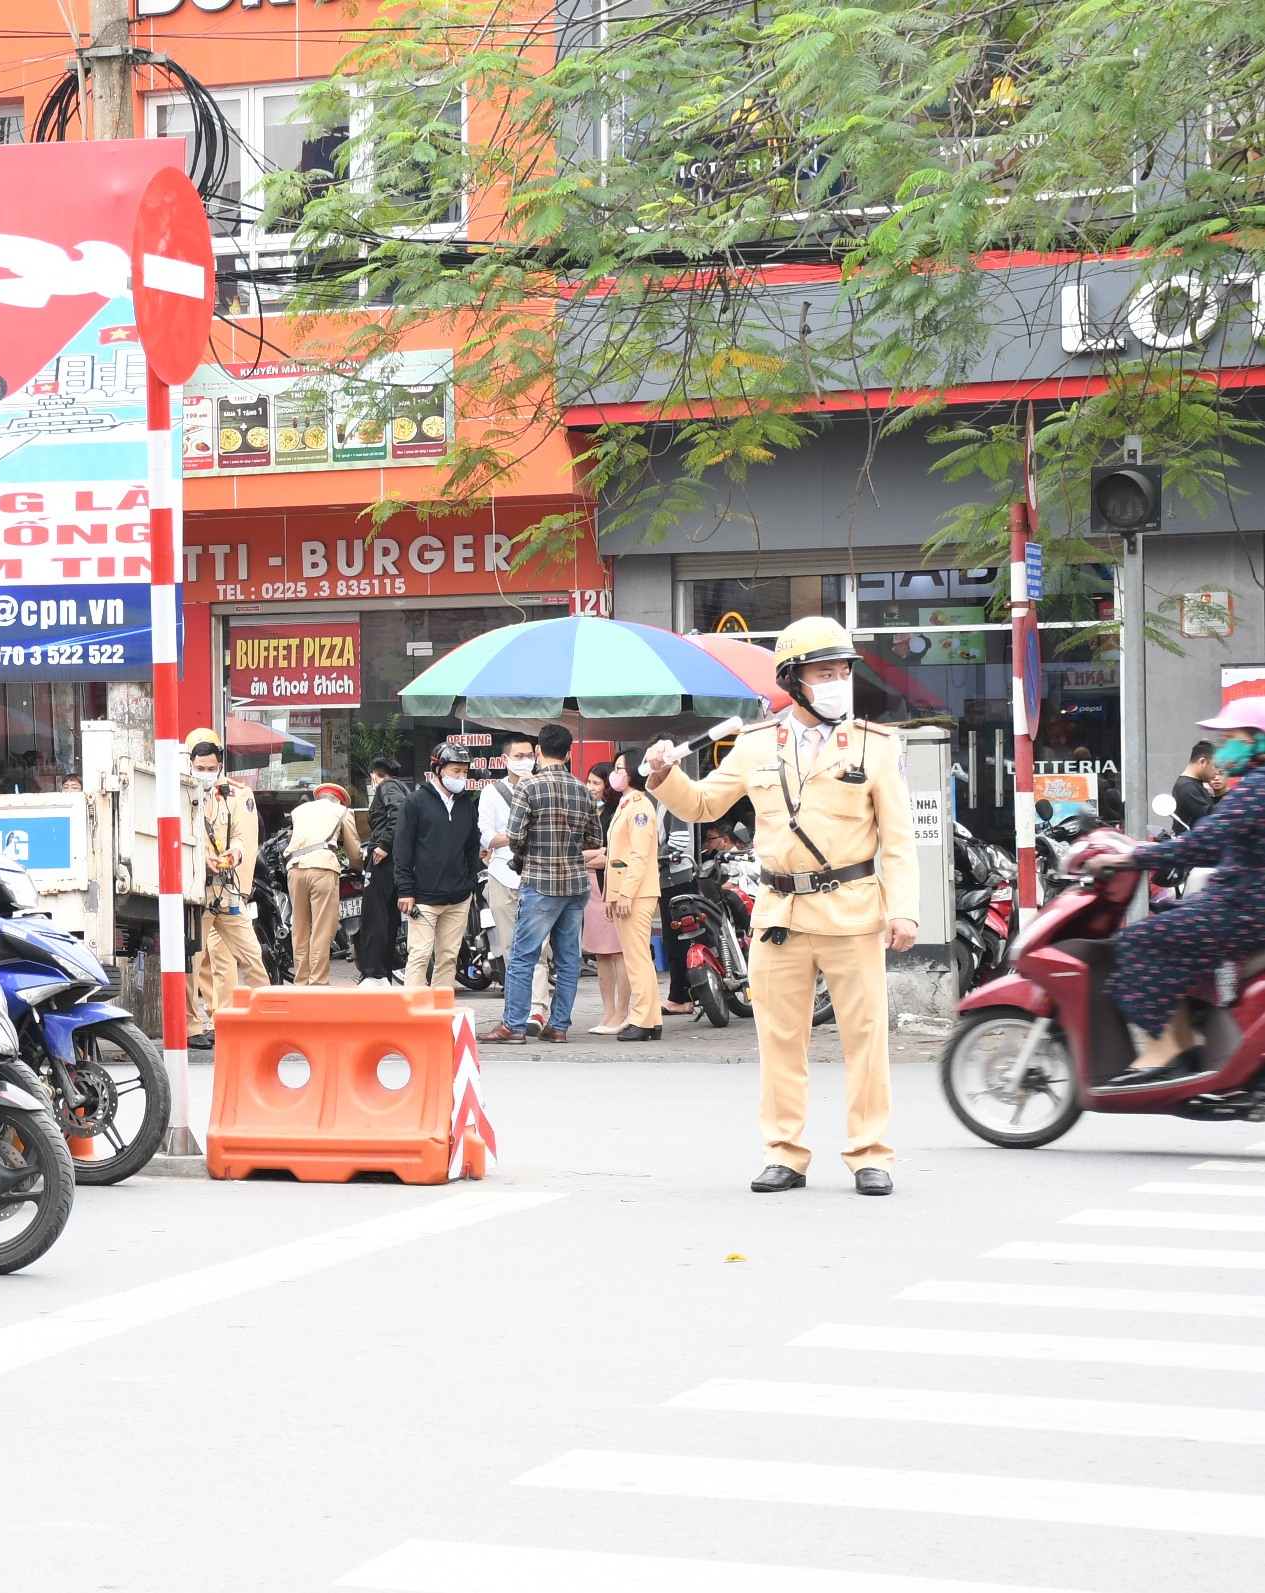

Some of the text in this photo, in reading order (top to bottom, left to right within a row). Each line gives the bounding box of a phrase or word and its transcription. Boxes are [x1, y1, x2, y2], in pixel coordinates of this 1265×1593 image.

[75, 485, 149, 512] LÀ
[51, 556, 152, 578] TIN
[302, 535, 513, 578] BURGER
[217, 584, 245, 600] TEL
[261, 582, 307, 599] 0225
[336, 578, 406, 596] 835115
[572, 590, 613, 617] 120
[30, 646, 42, 665] 3
[47, 645, 83, 665] 522
[88, 644, 125, 664] 522
[236, 636, 355, 670] BUFFET PIZZA
[776, 638, 795, 653] SGT
[250, 676, 268, 696] ăn
[314, 672, 354, 695] thích
[447, 734, 492, 746] OPENING
[1007, 759, 1118, 775] LTTERIA
[918, 814, 937, 826] HIỆU
